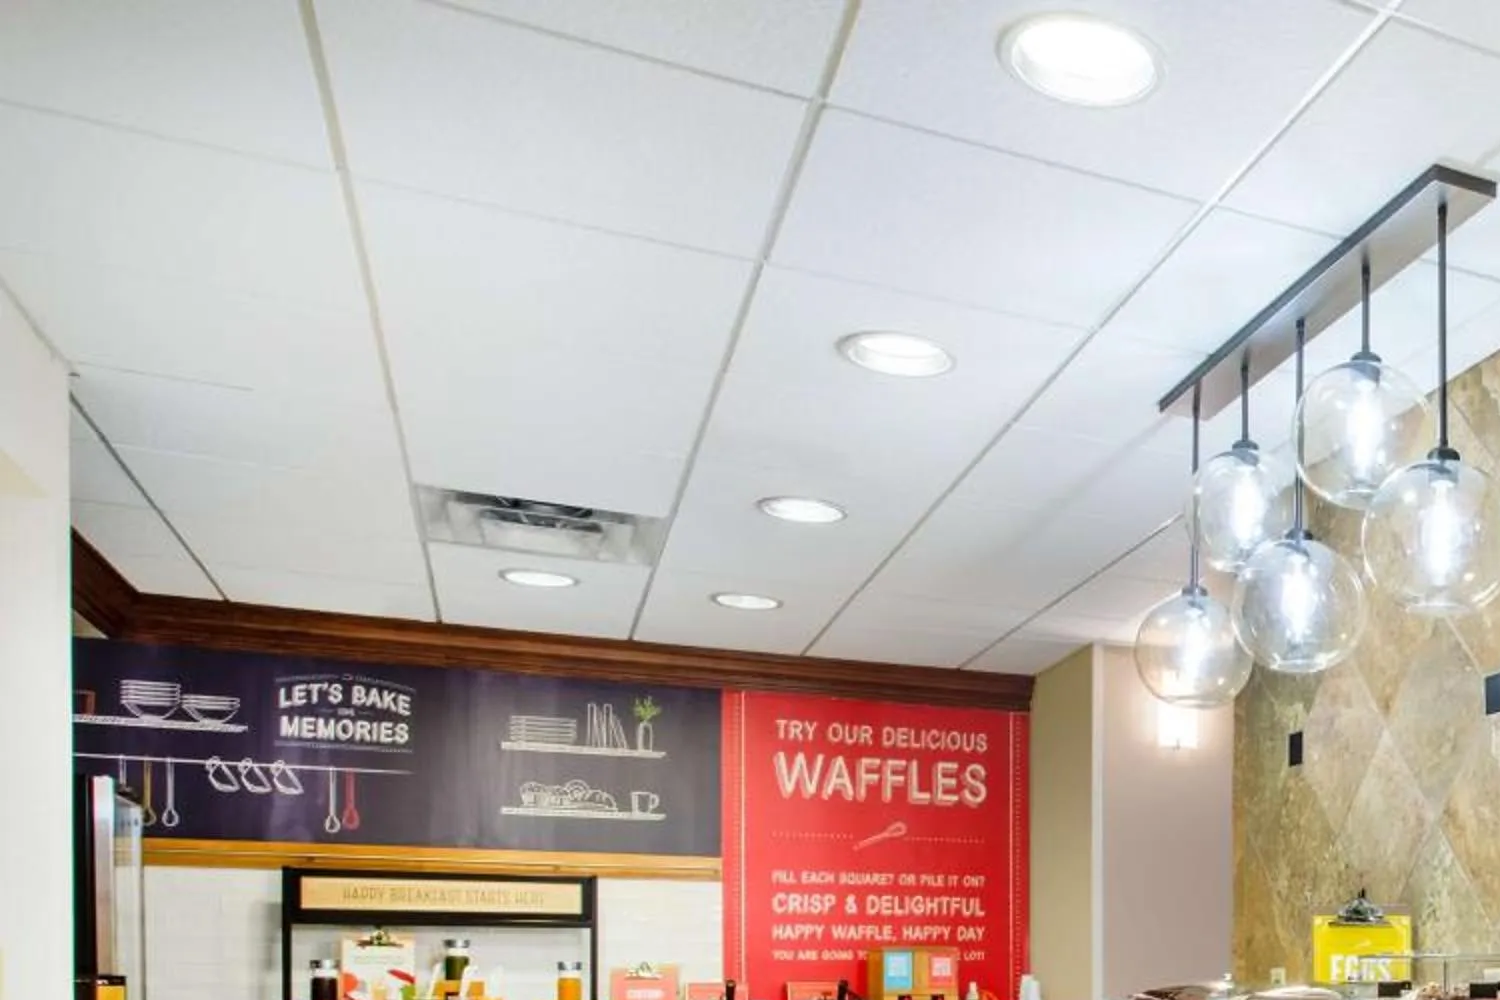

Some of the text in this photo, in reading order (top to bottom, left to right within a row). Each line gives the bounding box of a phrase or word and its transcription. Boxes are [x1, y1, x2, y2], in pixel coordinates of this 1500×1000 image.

[279, 681, 412, 716] LET'S BAKE
[279, 715, 409, 744] MEMORIES
[776, 719, 988, 753] TRY OUR DELICIOUS
[773, 751, 988, 808] WAFFLES
[772, 892, 985, 917] CRISP & DELIGHTFUL
[772, 923, 986, 943] HAPPY WAFFLE, HAPPY DAY
